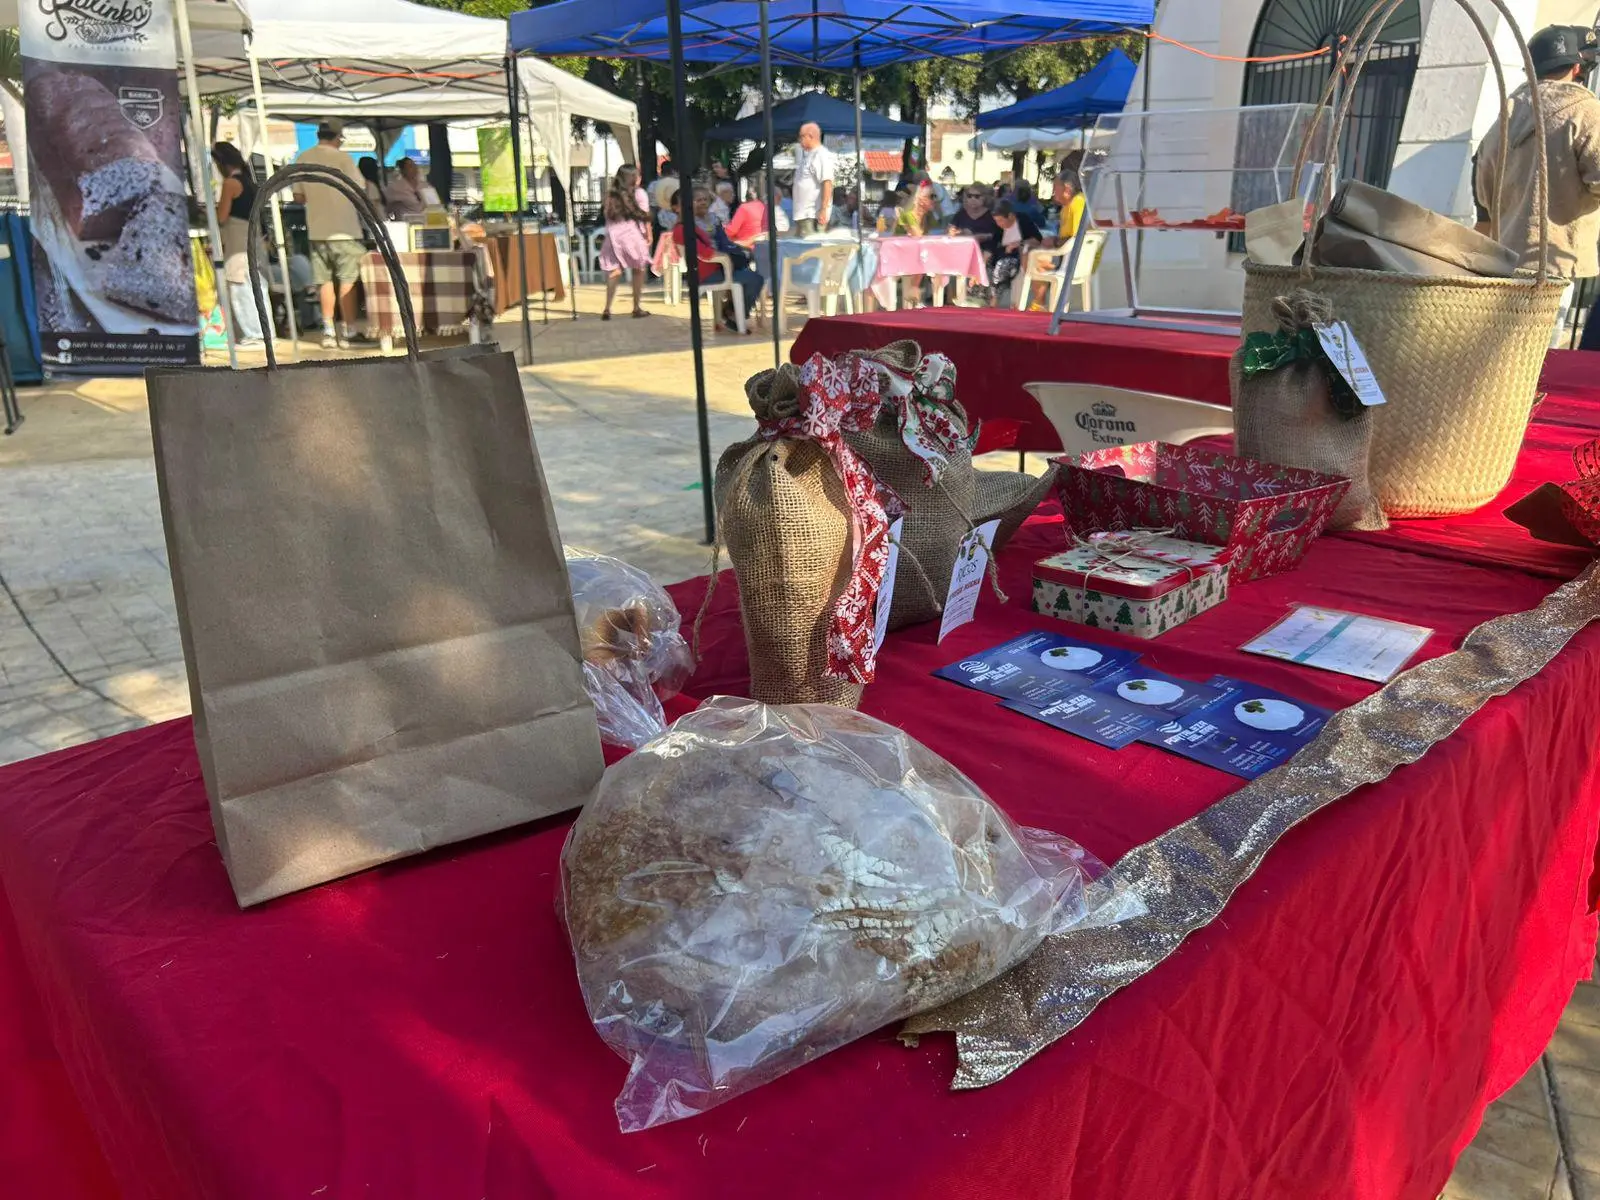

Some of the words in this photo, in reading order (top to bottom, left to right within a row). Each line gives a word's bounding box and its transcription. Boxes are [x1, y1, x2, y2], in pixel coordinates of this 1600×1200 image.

[1075, 412, 1136, 432] Corona
[1091, 430, 1124, 444] Extra
[1039, 694, 1088, 716] FORTALEZA
[1163, 720, 1209, 745] FORTALEZA
